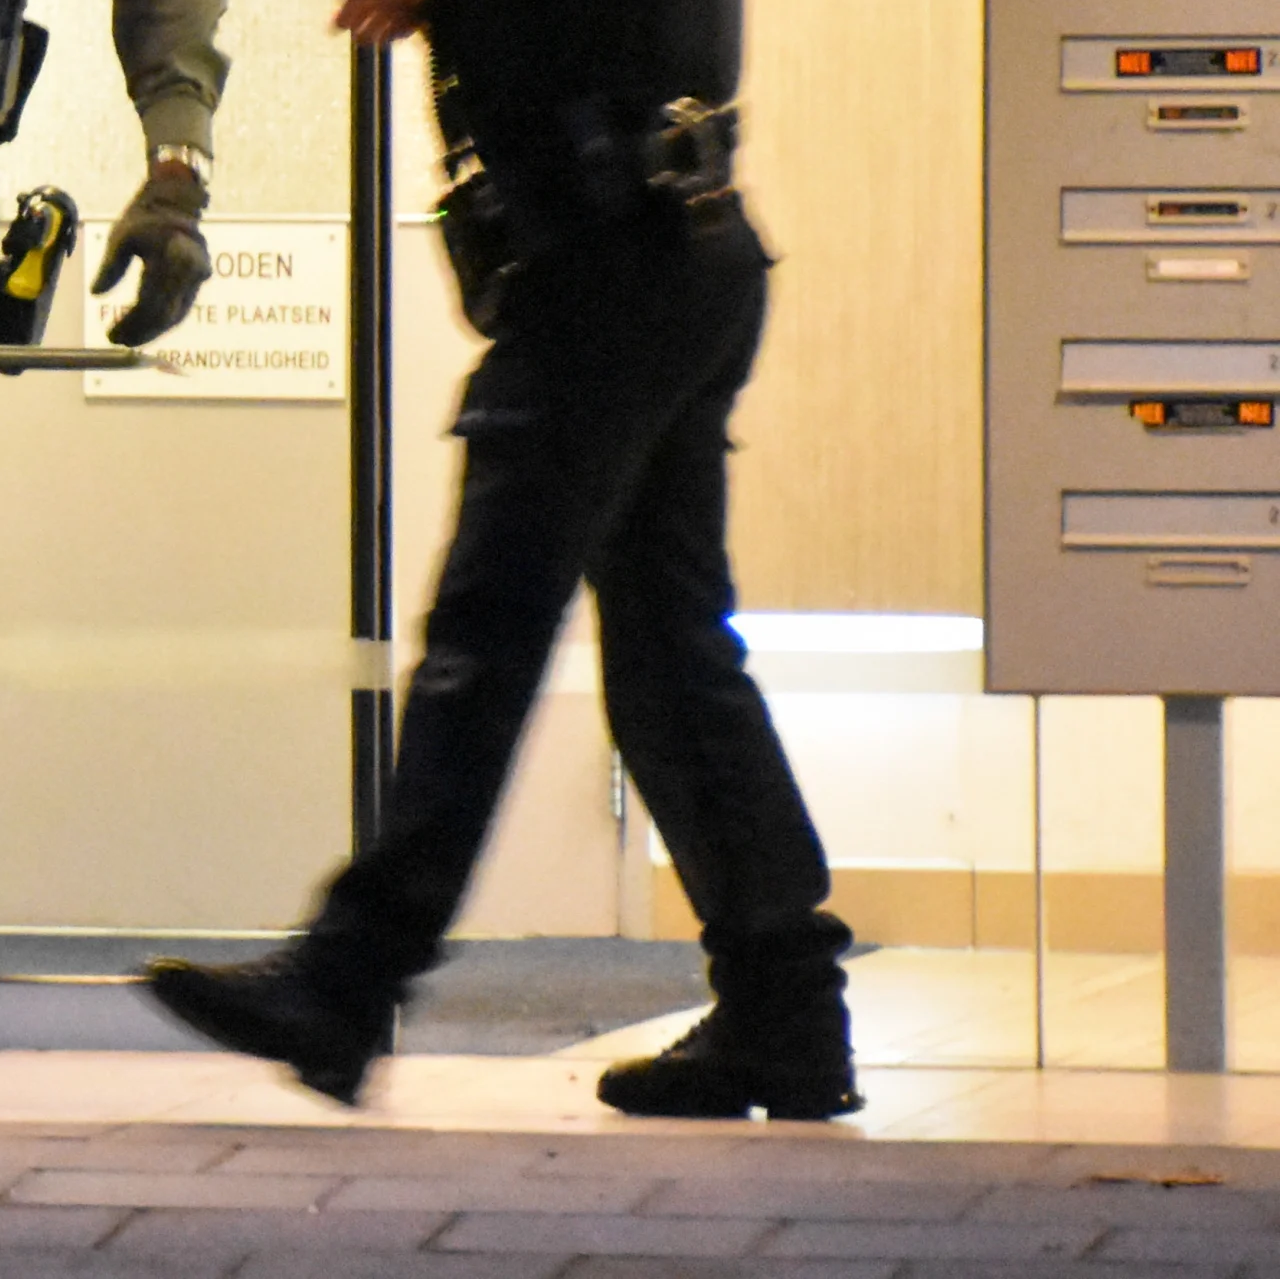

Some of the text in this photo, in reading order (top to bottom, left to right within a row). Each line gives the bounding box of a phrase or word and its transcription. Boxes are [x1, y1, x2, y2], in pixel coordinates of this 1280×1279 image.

[215, 251, 294, 278] ODEN
[195, 304, 332, 325] TE PLAATSEN
